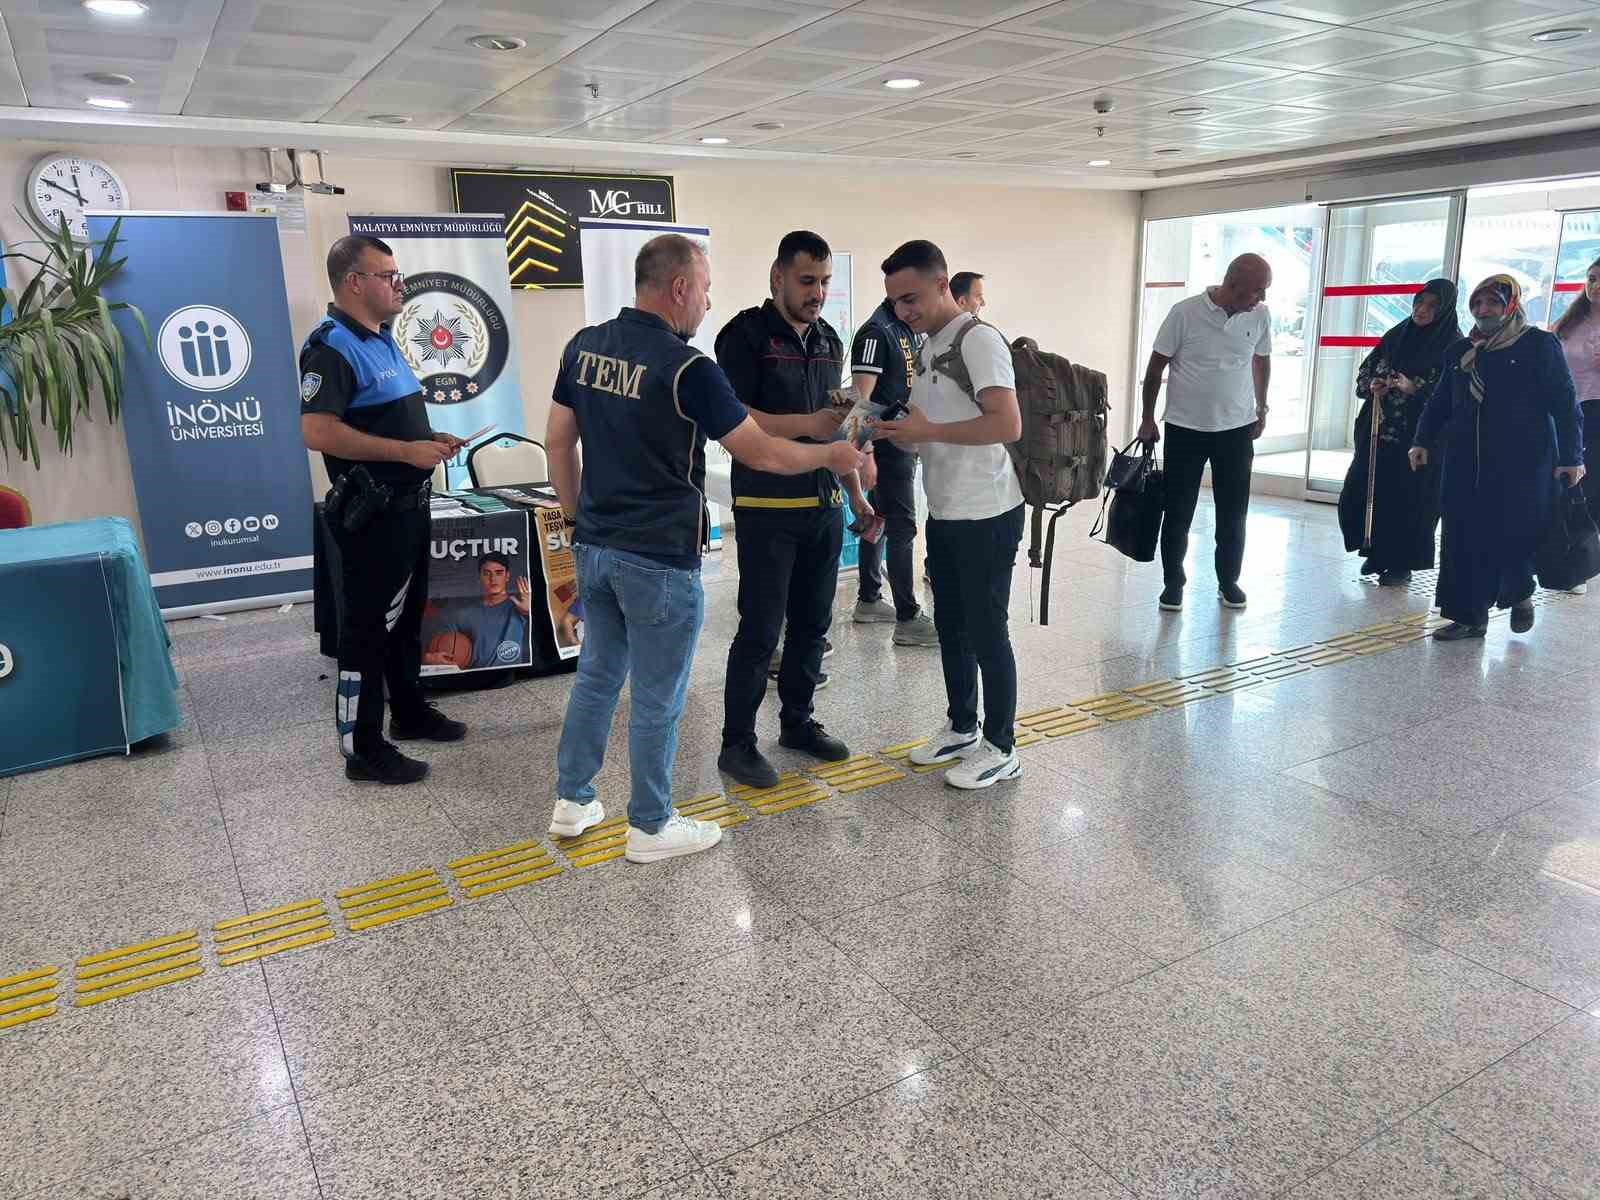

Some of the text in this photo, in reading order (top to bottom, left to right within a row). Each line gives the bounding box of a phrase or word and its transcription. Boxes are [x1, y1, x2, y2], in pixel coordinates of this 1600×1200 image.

[588, 189, 665, 217] MG HILL
[352, 221, 502, 233] MALATYA EMNİYET MÜDÜRLÜĞÜ
[435, 377, 457, 386] EGM
[576, 350, 648, 400] TEM
[166, 396, 262, 426] İNÖNÜ
[170, 421, 264, 441] ÜNİVERSİTESİ
[430, 537, 519, 561] UÇTUR
[196, 560, 281, 579] www.inonu.edu.tr
